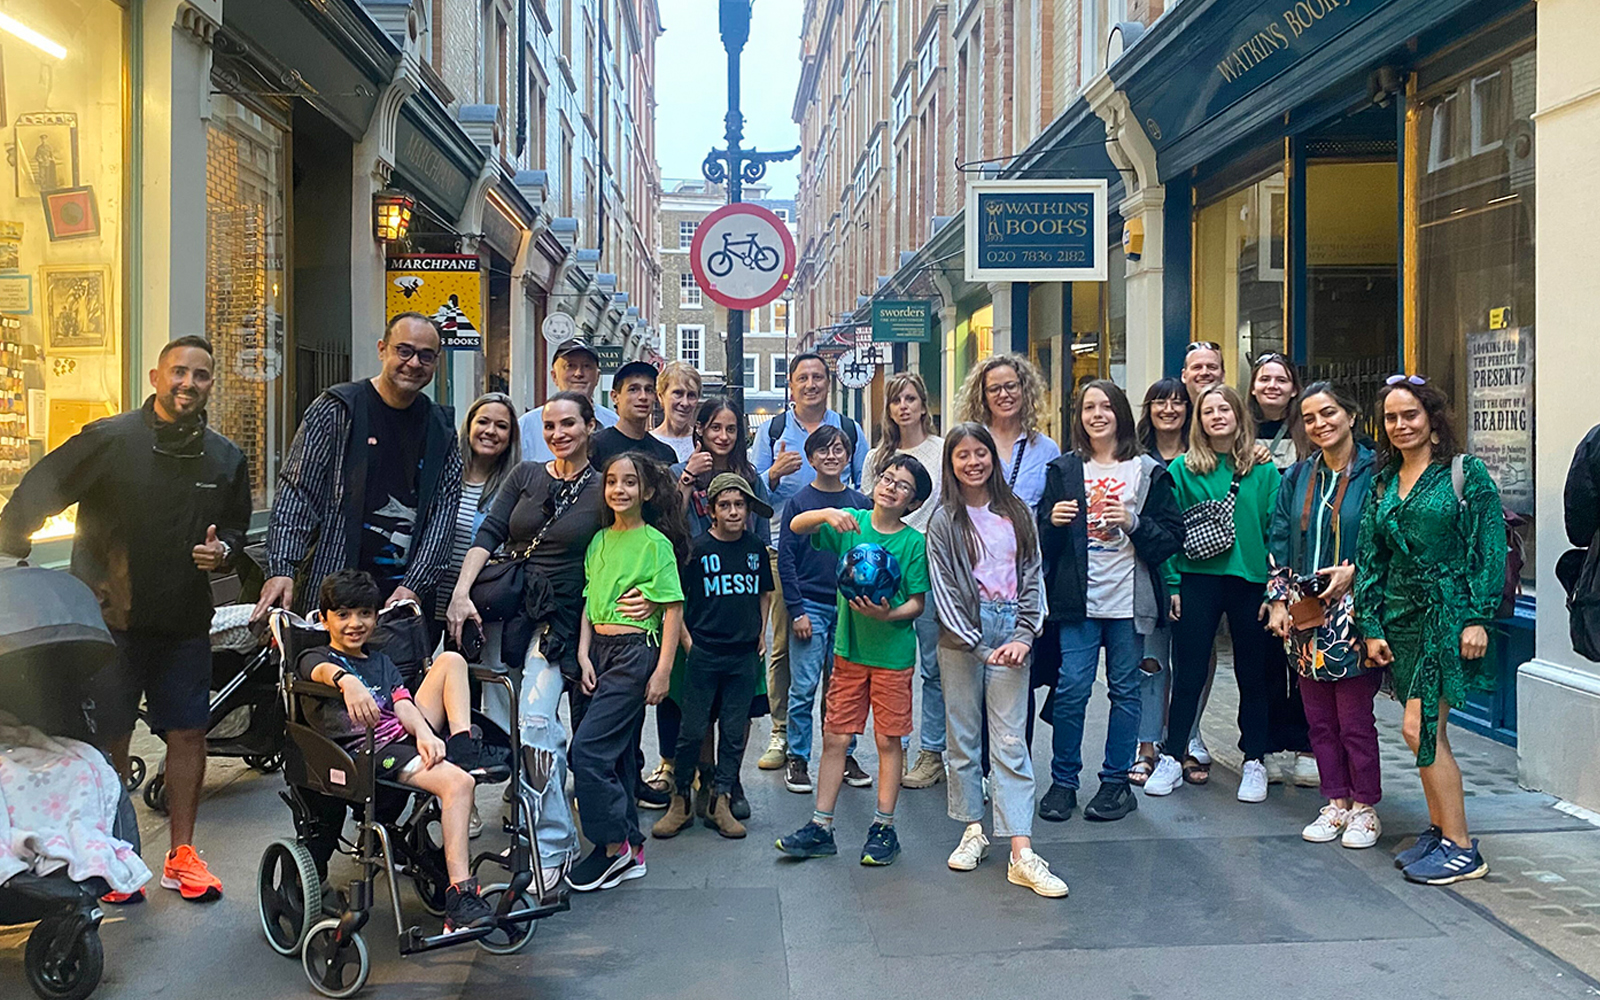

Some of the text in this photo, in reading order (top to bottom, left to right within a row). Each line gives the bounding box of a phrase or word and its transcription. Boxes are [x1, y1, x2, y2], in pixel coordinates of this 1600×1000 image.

[1216, 0, 1350, 83] WATKINS BOO
[403, 132, 458, 196] MARCHPANE
[1005, 202, 1089, 216] WATKINS
[1006, 219, 1088, 238] BOOKS
[986, 250, 1086, 262] 020 7836 2182
[391, 258, 477, 270] MARCHPANE
[879, 306, 925, 317] sworders
[447, 337, 480, 346] BOOKS
[1473, 340, 1516, 355] LOOKING FOR
[1473, 353, 1516, 368] THE PERFECT
[1473, 366, 1526, 388] PRESENT?
[1473, 399, 1486, 409] GIVE
[1487, 399, 1498, 409] THE
[1499, 398, 1512, 408] GIFT
[1513, 398, 1521, 407] OF
[1473, 409, 1527, 431] READING
[700, 553, 721, 574] 10
[852, 551, 881, 562] SPRS
[703, 573, 760, 597] MESSI
